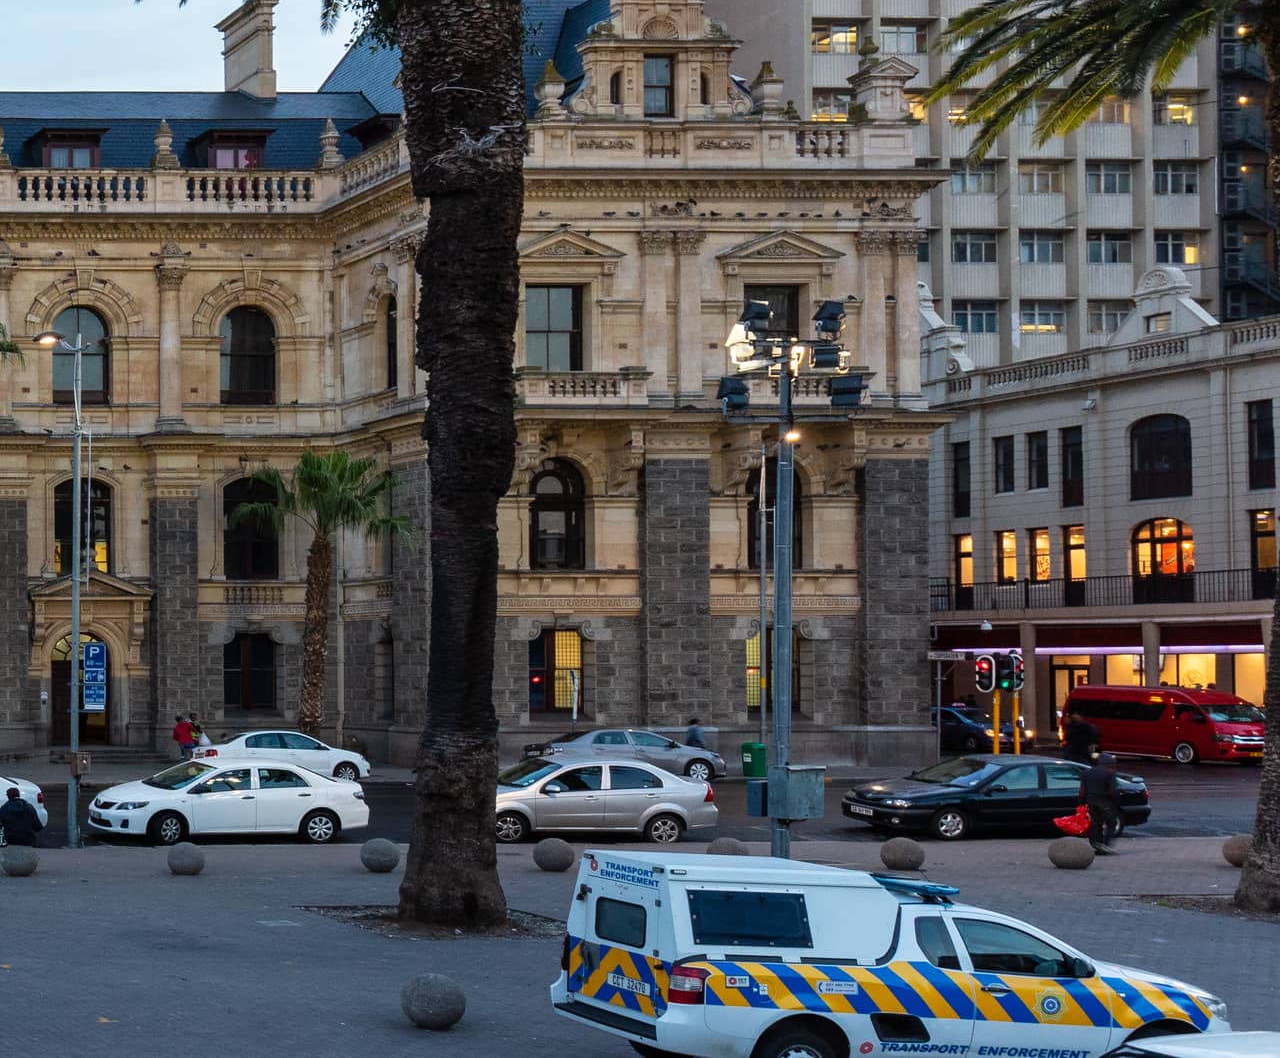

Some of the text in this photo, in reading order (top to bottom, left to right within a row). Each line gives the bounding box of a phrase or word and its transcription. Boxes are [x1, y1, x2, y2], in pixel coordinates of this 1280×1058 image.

[89, 646, 100, 658] P
[604, 861, 655, 878] TRANSPORT
[600, 869, 660, 888] ENFORCEMENT
[612, 975, 625, 988] CCT
[880, 1042, 1091, 1058] TRANSPORT ENFORCEMENT
